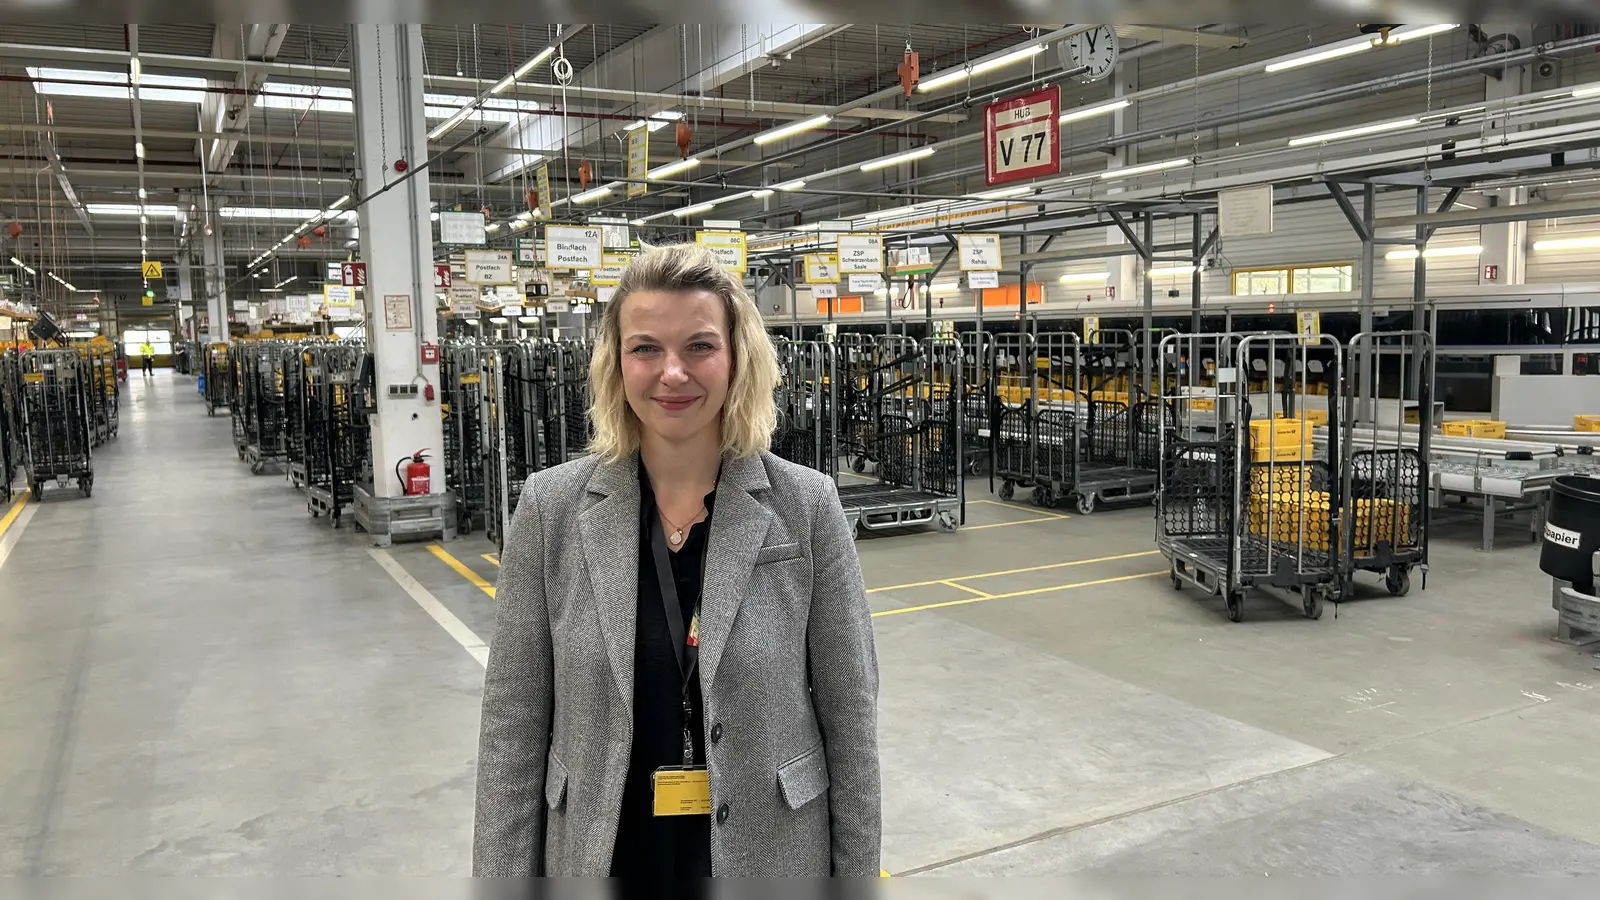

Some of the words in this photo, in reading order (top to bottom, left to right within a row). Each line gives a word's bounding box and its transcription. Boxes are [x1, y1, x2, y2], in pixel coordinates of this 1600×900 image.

[1014, 107, 1031, 119] HUB
[1000, 137, 1014, 166] V
[1021, 131, 1046, 163] 77
[585, 230, 598, 239] 12A
[556, 243, 587, 251] Bindlach
